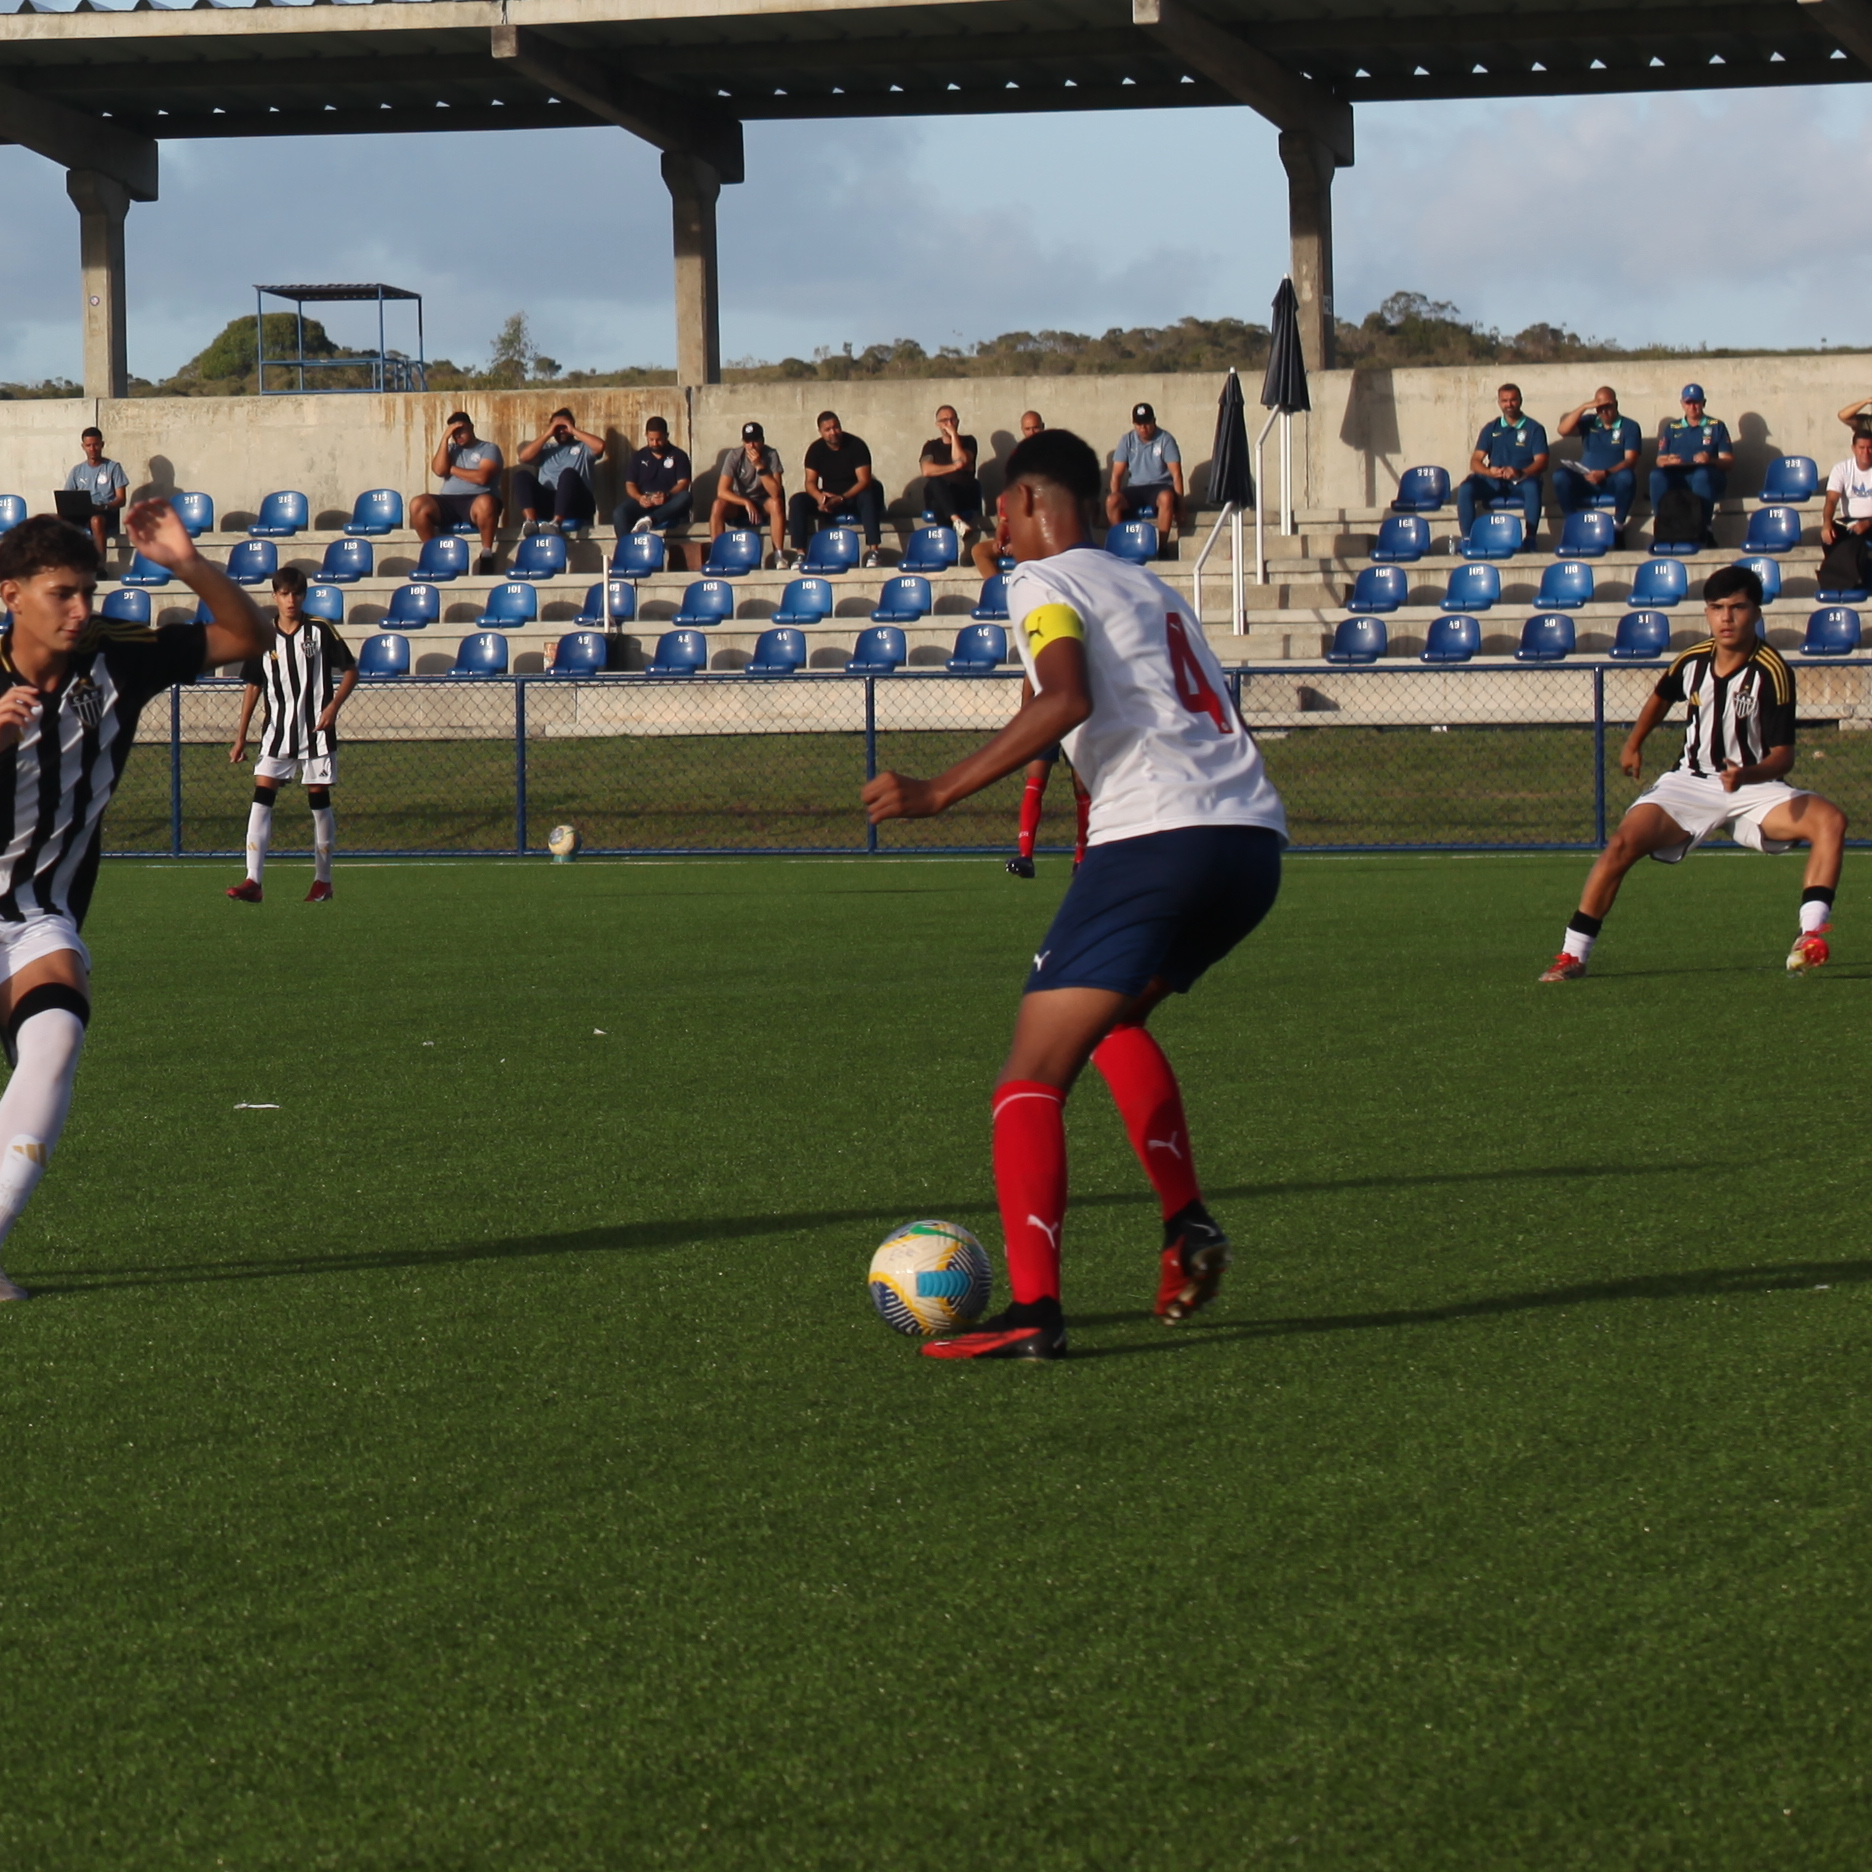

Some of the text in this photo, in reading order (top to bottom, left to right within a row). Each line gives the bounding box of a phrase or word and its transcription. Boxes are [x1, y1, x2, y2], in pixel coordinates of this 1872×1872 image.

[1490, 516, 1505, 525] 169
[1126, 524, 1140, 533] 167
[829, 531, 843, 540] 164
[928, 530, 942, 539] 165
[536, 539, 549, 547] 161
[1565, 565, 1578, 575] 110
[1655, 566, 1667, 575] 111
[802, 581, 817, 589] 104
[901, 579, 916, 588] 105
[410, 586, 426, 595] 100
[507, 585, 521, 594] 101
[1544, 618, 1556, 627] 50
[1638, 614, 1649, 624] 51
[777, 632, 787, 640] 44
[877, 631, 887, 639] 45
[977, 628, 989, 637] 46
[1166, 612, 1234, 734] 4
